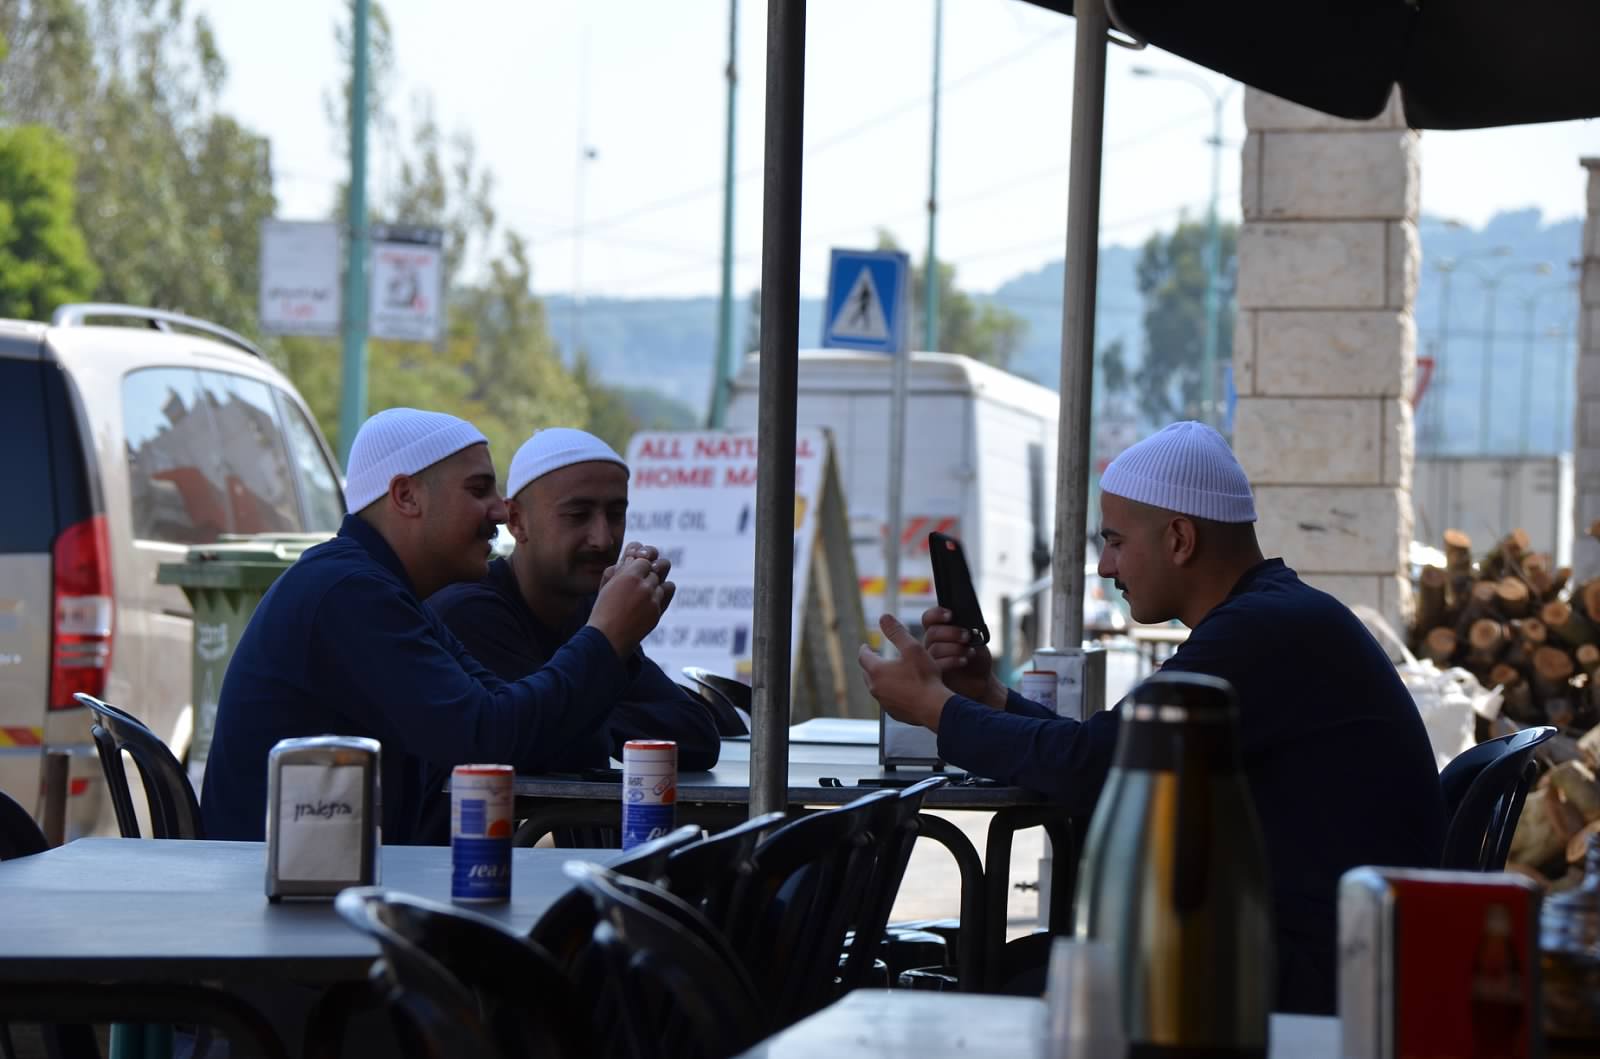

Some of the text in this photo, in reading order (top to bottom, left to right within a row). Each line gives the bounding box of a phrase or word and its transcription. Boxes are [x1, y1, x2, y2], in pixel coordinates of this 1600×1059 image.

[639, 437, 815, 460] ALL NATUL
[635, 466, 715, 489] HOME
[678, 509, 706, 531] OIL
[467, 863, 498, 878] sea
